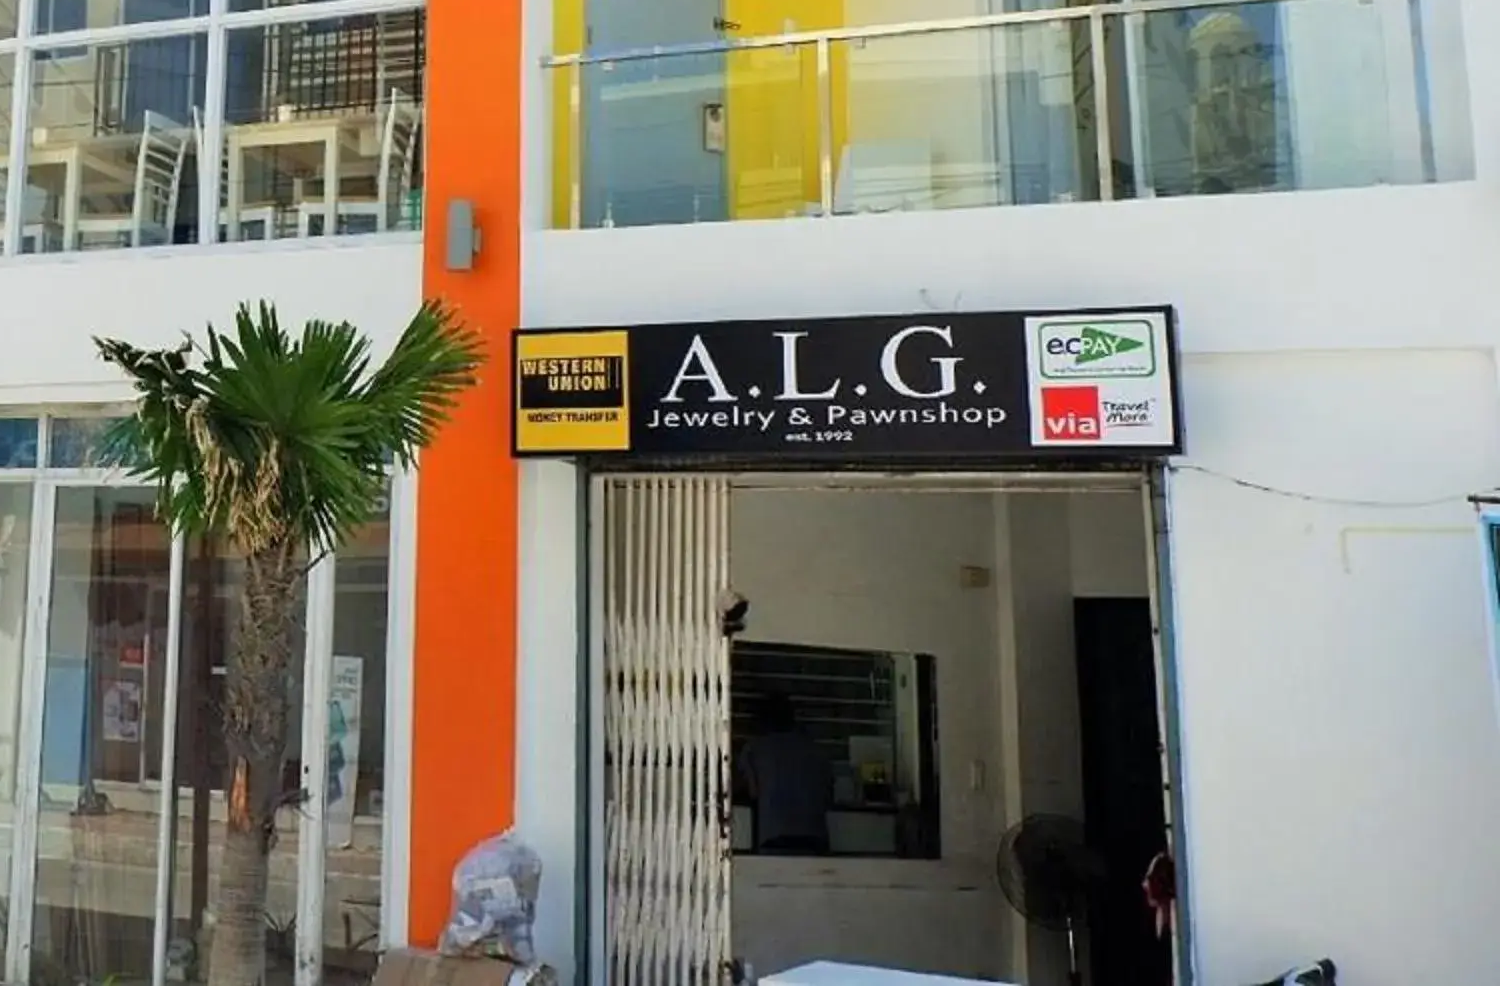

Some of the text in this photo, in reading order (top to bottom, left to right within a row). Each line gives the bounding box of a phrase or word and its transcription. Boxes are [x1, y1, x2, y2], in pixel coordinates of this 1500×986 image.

[522, 358, 606, 375] WESTERN
[660, 325, 988, 403] A.L.G.
[548, 375, 606, 391] UNION
[647, 402, 1006, 431] Jewelry & Pawnshop
[1045, 411, 1098, 435] via
[815, 430, 853, 441] 1992
